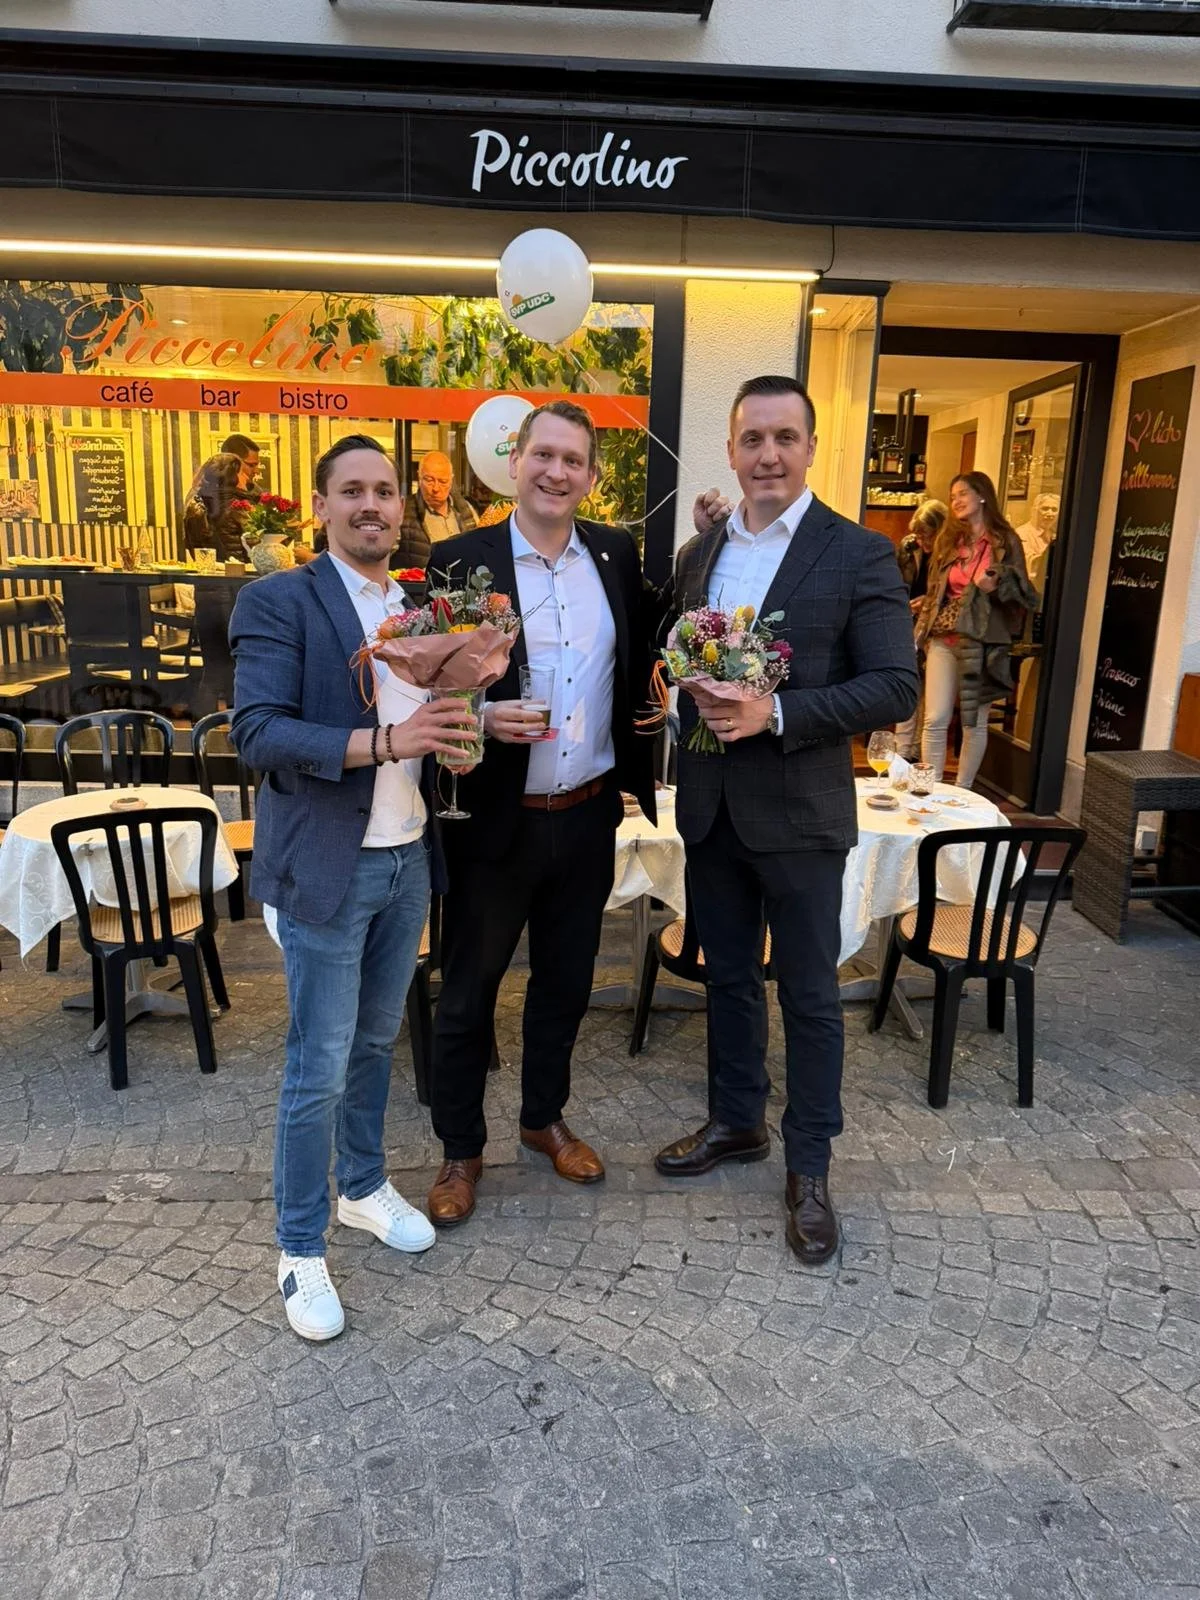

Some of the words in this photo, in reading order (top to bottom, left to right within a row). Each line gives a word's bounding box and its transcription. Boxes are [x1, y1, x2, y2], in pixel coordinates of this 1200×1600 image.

[470, 129, 689, 192] Piccolino
[510, 302, 526, 317] SVP
[526, 292, 551, 309] UDC
[60, 297, 375, 373] Piccolino
[100, 381, 154, 404] café
[200, 384, 241, 407] bar
[279, 387, 348, 411] bistro
